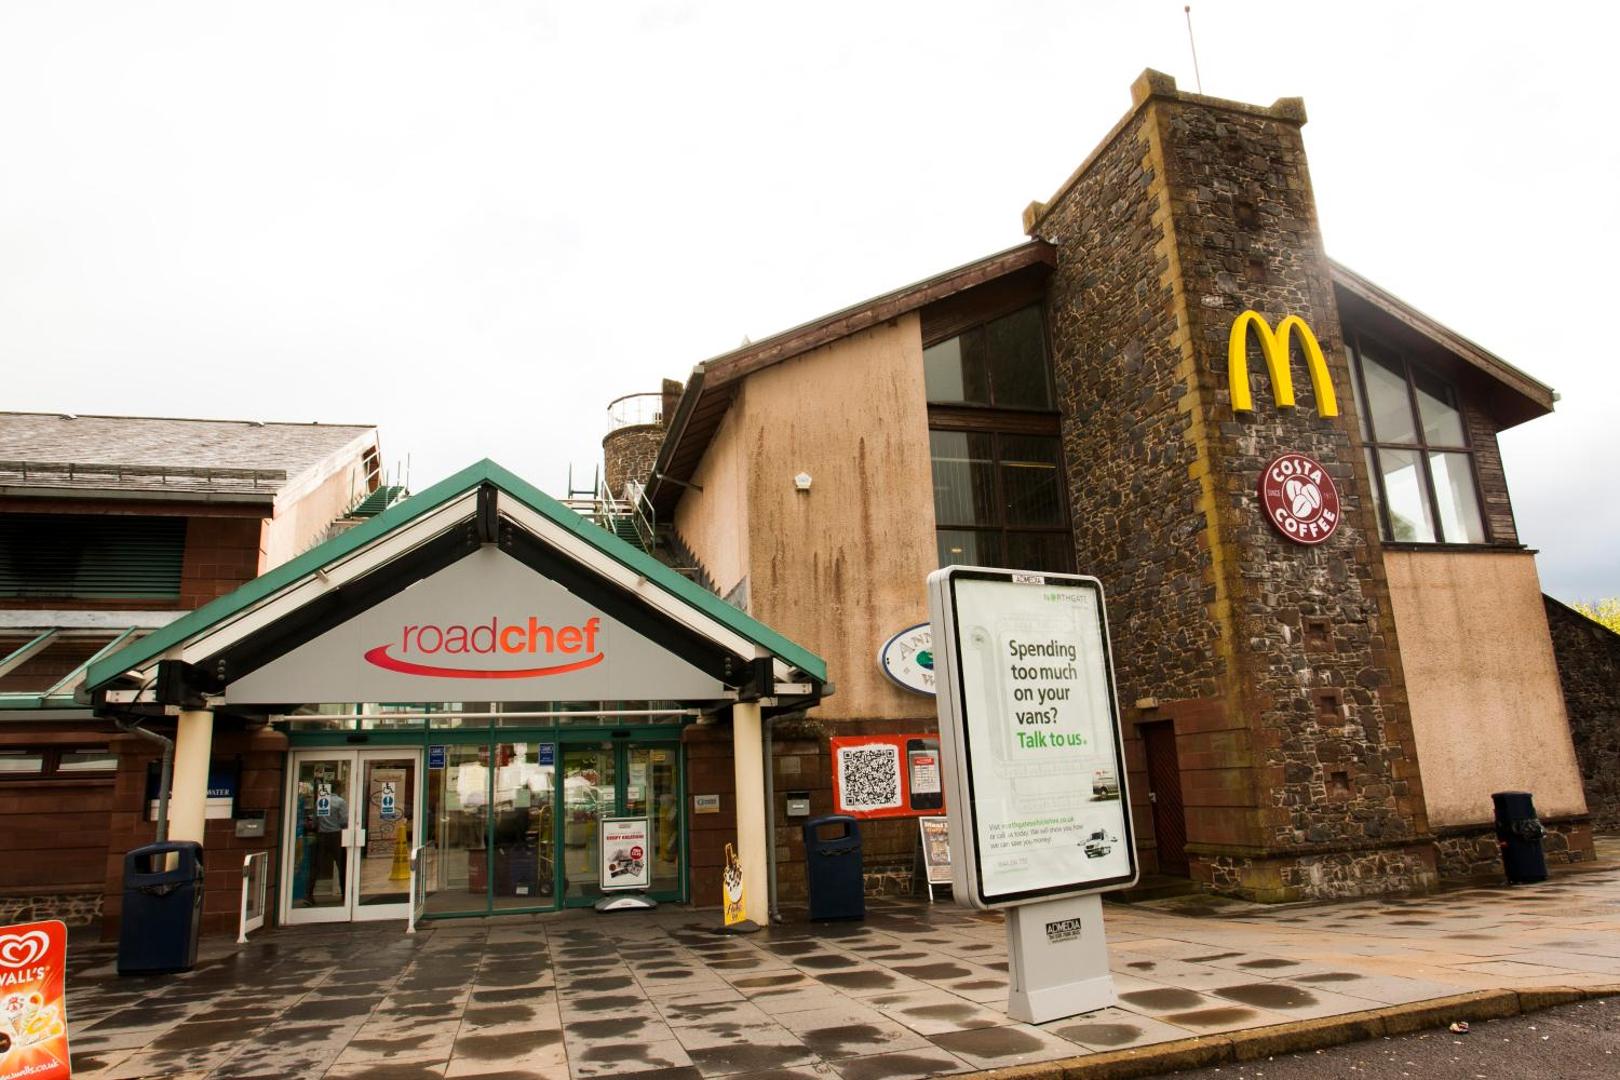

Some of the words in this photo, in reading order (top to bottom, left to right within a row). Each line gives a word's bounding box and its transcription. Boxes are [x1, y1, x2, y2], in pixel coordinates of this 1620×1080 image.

[1272, 460, 1322, 485] COSTA
[1275, 508, 1336, 538] COFFEE
[402, 617, 600, 654] roadchef
[1009, 639, 1076, 661] Spending
[1011, 664, 1038, 680] too
[1039, 663, 1078, 680] much
[1014, 687, 1034, 701] on
[1037, 687, 1070, 705] your
[1016, 707, 1058, 725] vans?
[1017, 731, 1047, 748] Talk
[1050, 732, 1065, 747] to
[1067, 733, 1087, 746] us.
[1048, 919, 1081, 933] ADMEDIA
